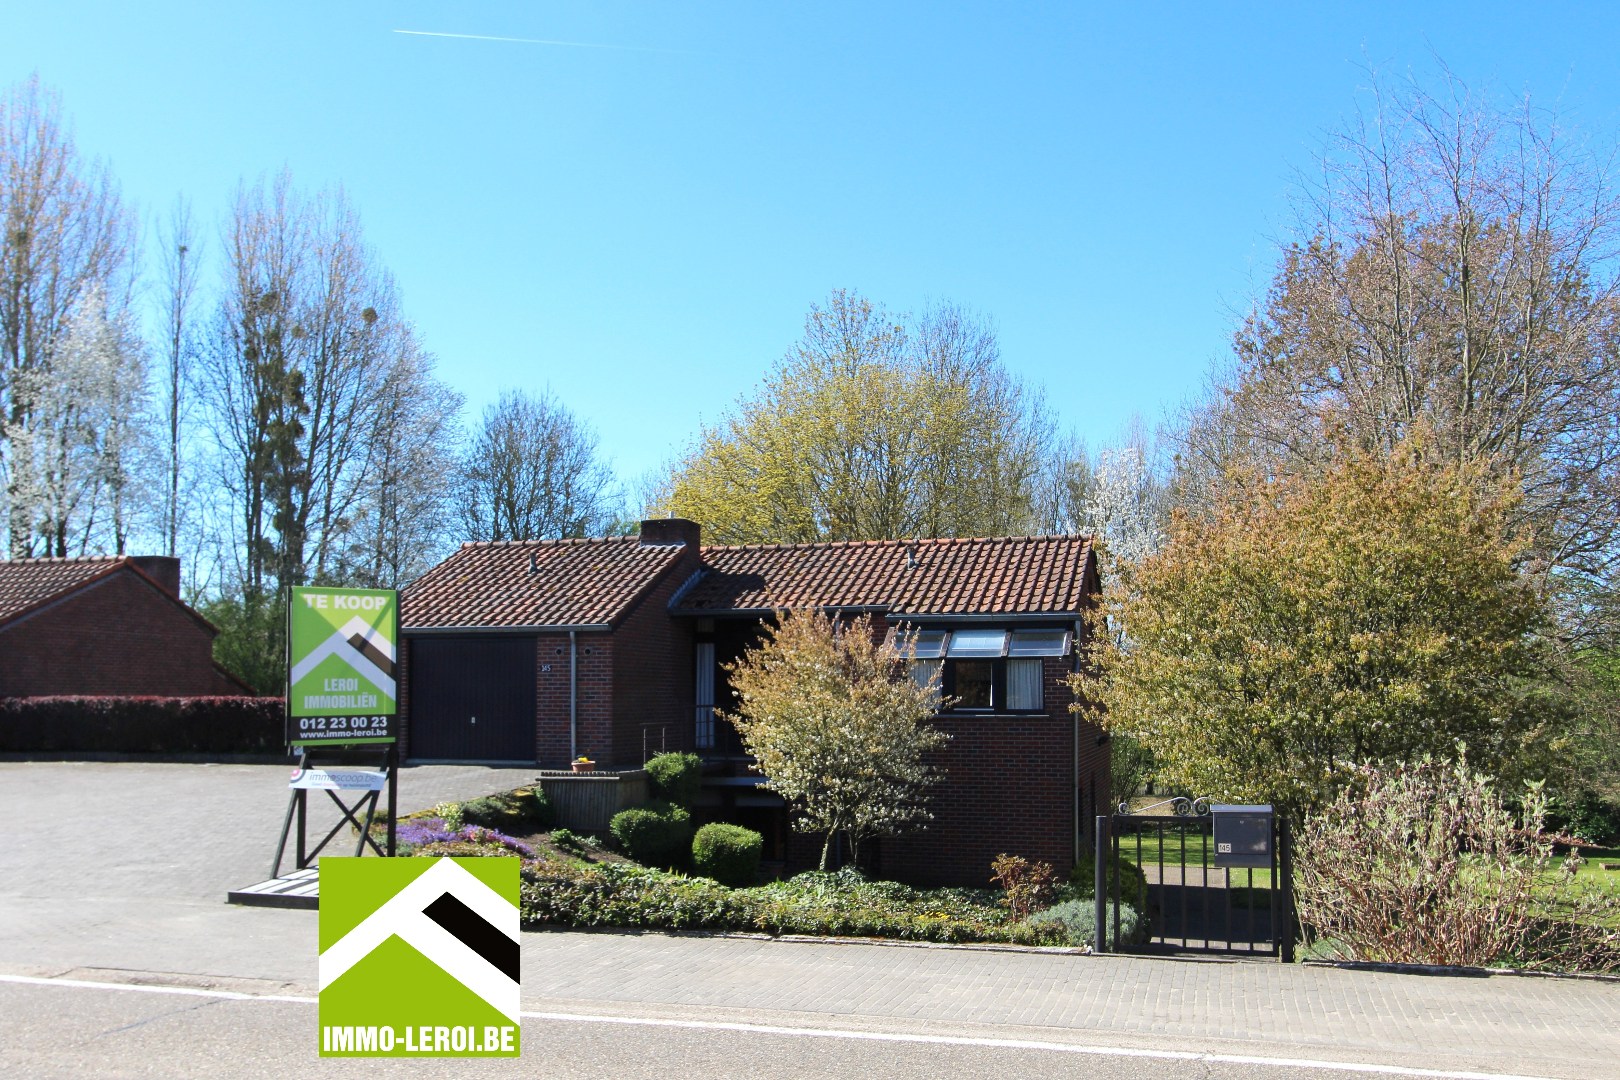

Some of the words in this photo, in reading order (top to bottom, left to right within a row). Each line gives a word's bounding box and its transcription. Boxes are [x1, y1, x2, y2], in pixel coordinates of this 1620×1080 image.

[303, 593, 328, 608] TE
[334, 595, 387, 610] KOOP
[324, 678, 359, 692] LEROI
[304, 692, 377, 709] IMMOBILIËN
[300, 718, 326, 730] 012
[330, 717, 347, 729] 23
[350, 717, 368, 728] 00
[371, 716, 388, 727] 23
[300, 729, 388, 739] www.immo-leroi.be
[309, 771, 377, 784] immoscoop.be
[1219, 844, 1231, 852] 145
